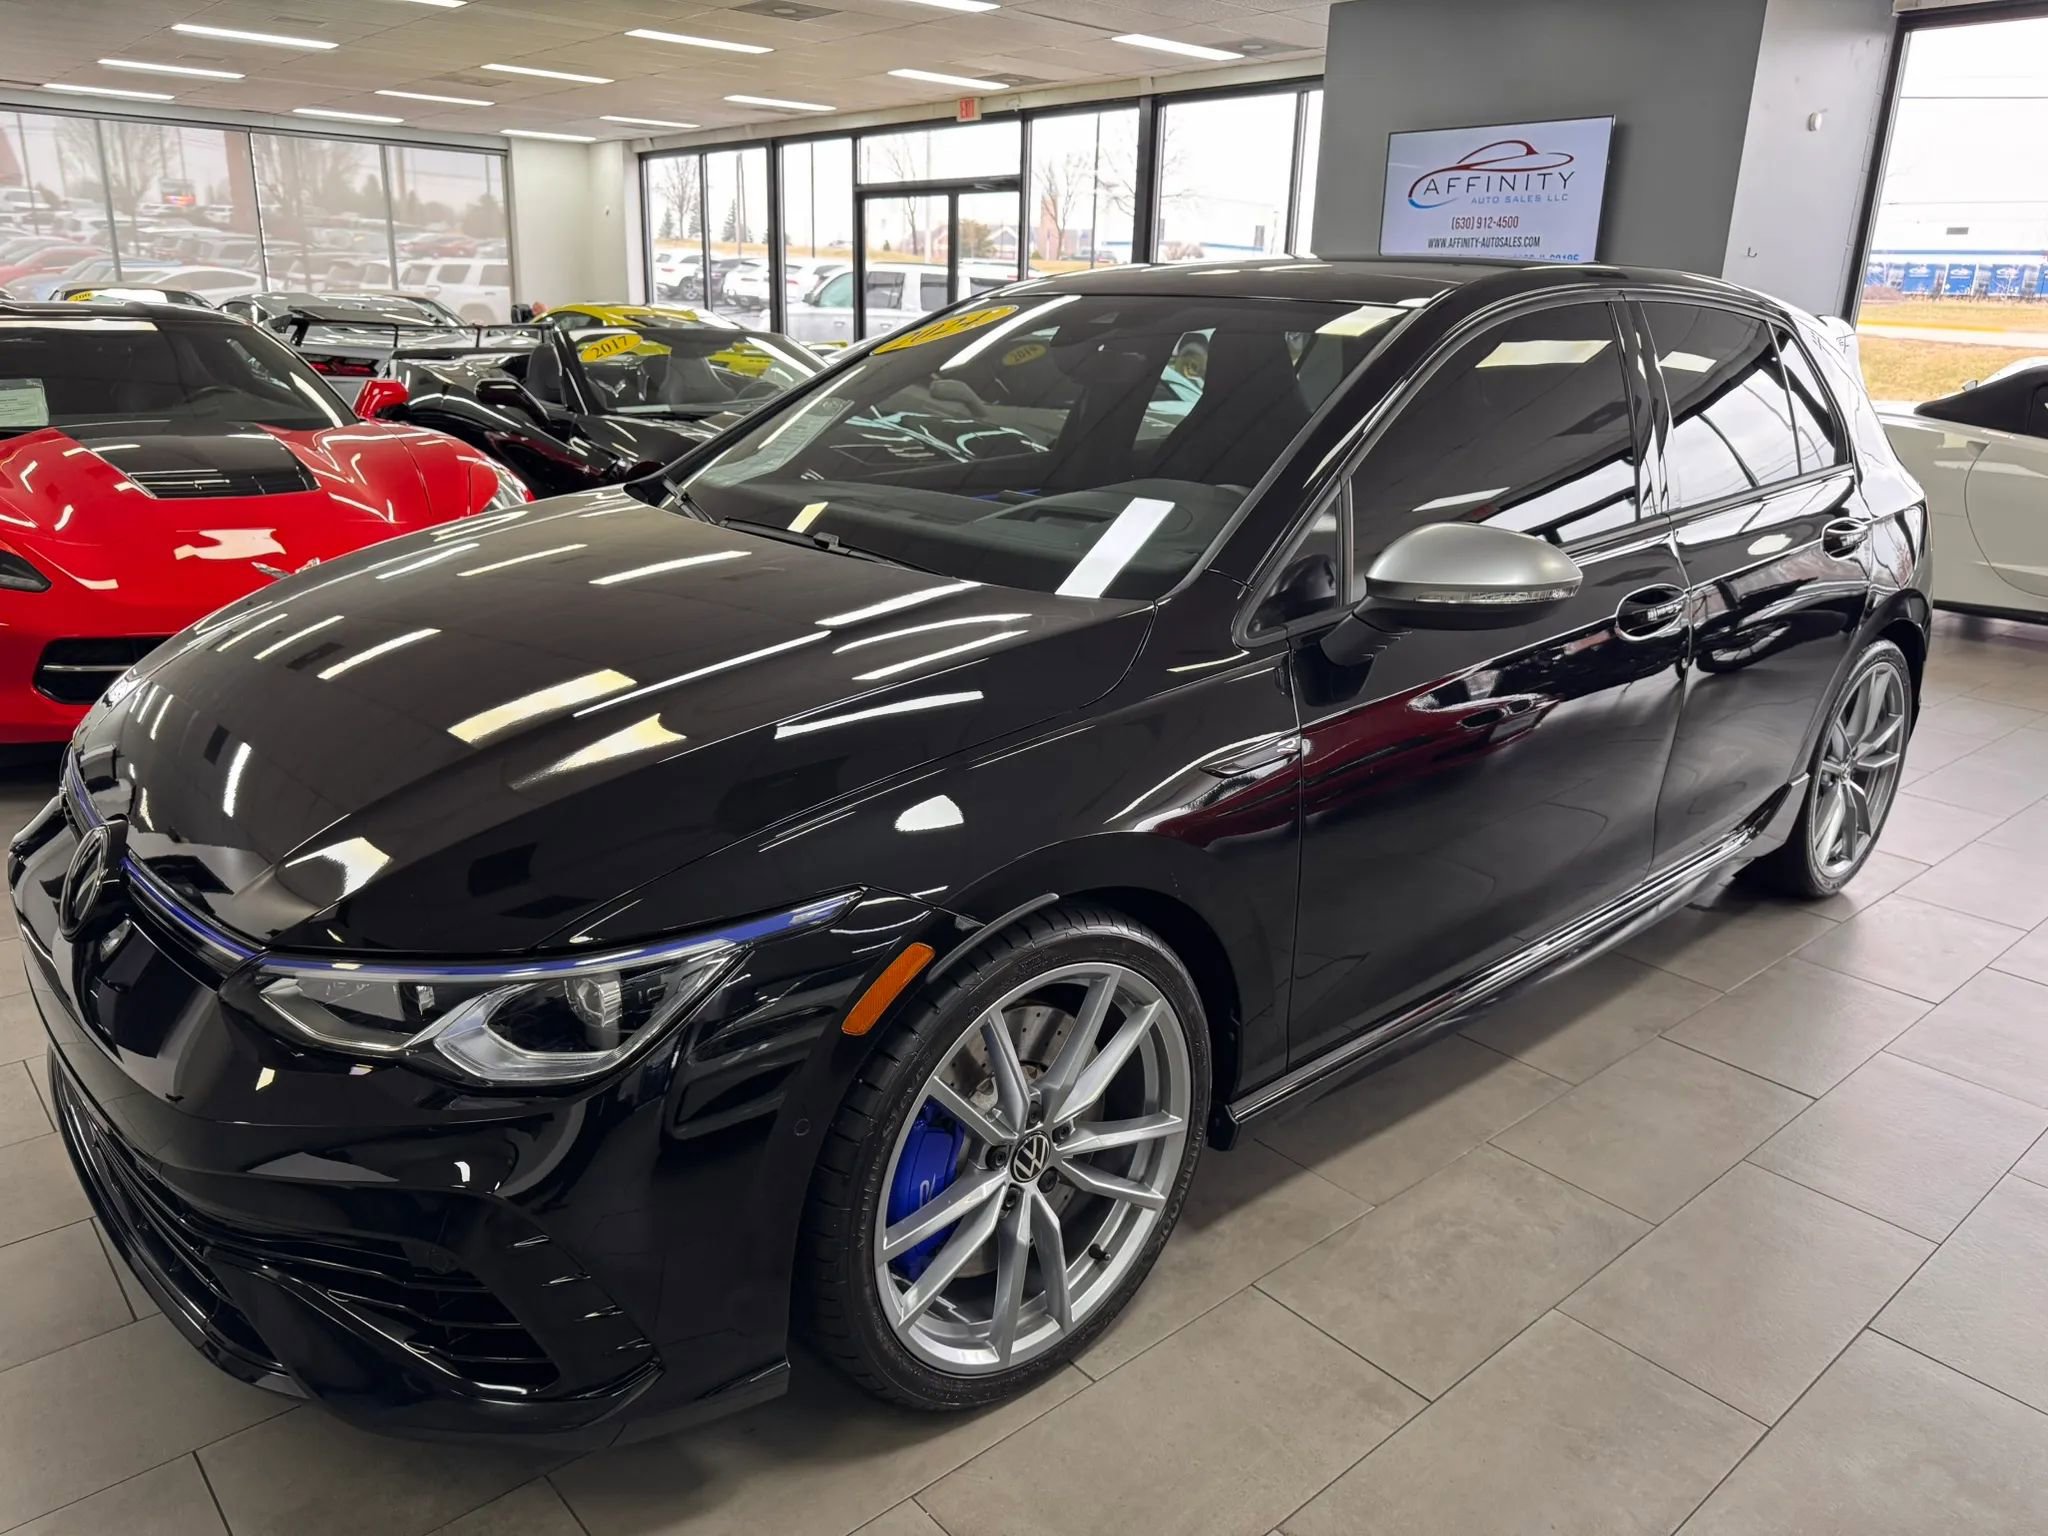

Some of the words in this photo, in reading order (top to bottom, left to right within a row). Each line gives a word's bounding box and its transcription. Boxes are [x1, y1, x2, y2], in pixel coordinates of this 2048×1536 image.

[1424, 171, 1575, 195] AFFINITY
[1471, 196, 1500, 204] AUTO
[1505, 194, 1541, 203] SALES
[1547, 193, 1568, 202] LLC
[1451, 217, 1475, 230] (630)
[1477, 215, 1519, 228] 912-4500
[1427, 236, 1540, 248] WWW.AFFINITY-AUTOSALES.COM
[592, 336, 627, 358] 2017
